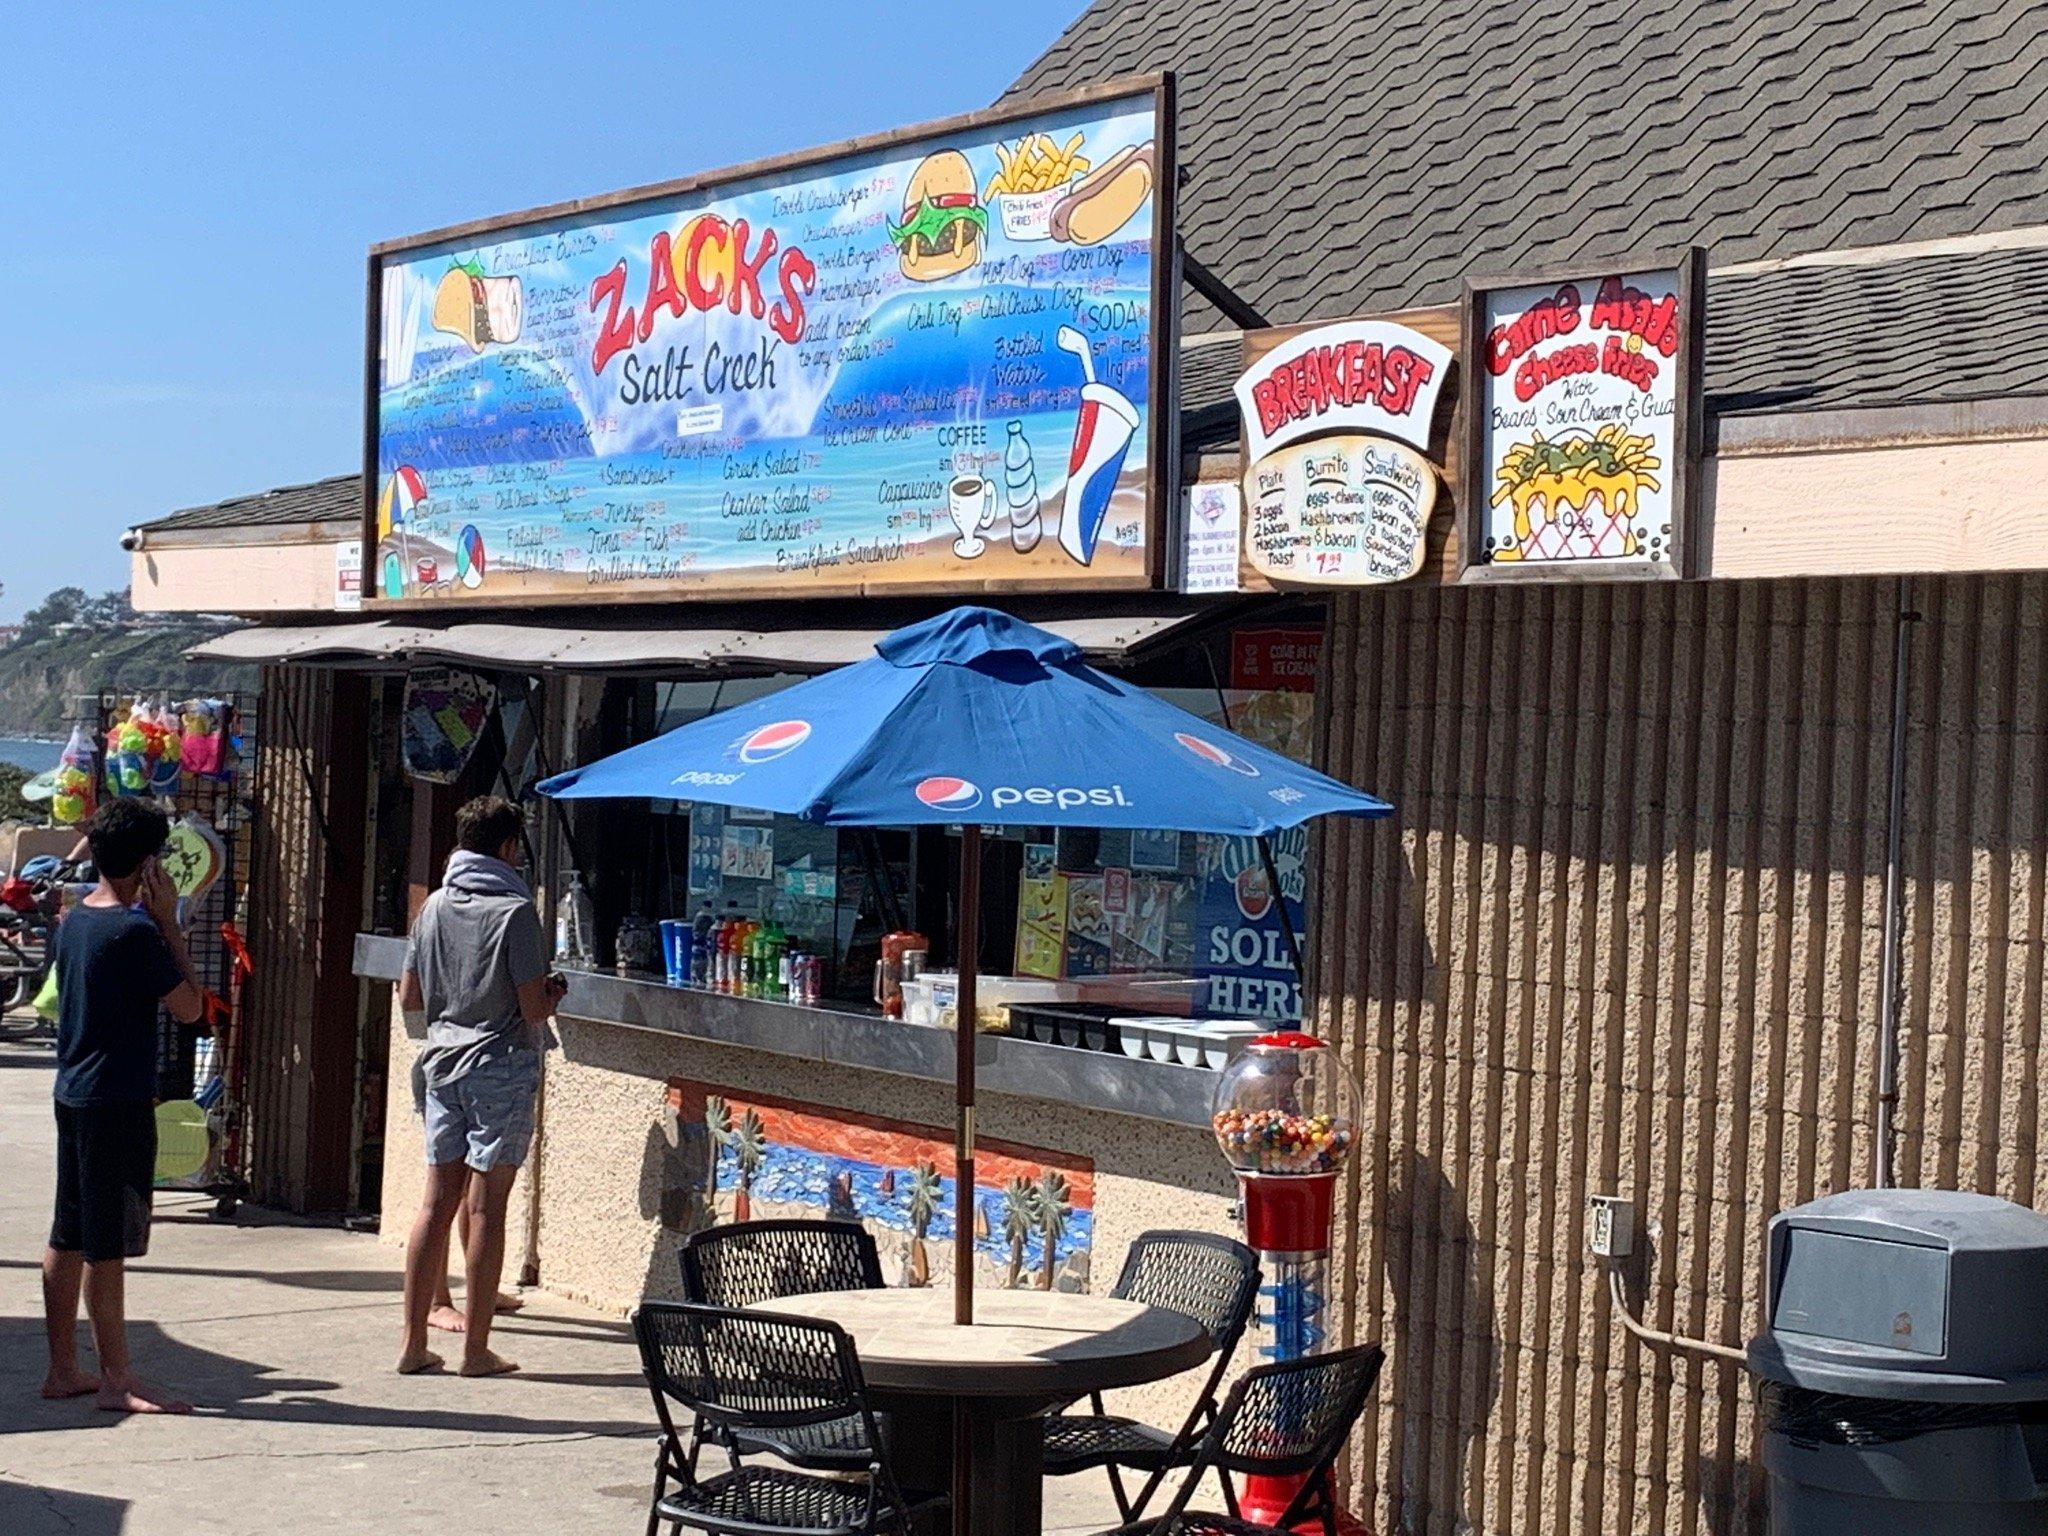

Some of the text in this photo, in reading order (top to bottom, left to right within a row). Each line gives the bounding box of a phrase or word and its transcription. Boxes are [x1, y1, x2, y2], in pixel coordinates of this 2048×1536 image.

[1062, 248, 1094, 273] Corn
[1051, 281, 1084, 323] Dog
[1088, 300, 1138, 333] SODA
[1485, 284, 1582, 376] Carne
[620, 345, 694, 404] Salt
[703, 336, 781, 395] Creek
[1514, 335, 1659, 403] Cheese Fries
[1253, 340, 1435, 439] BREAKFAST
[1491, 405, 1537, 430] Beans
[1546, 401, 1577, 426] Sour
[1579, 398, 1623, 423] Cream
[938, 426, 986, 447] COFFEE
[1306, 454, 1348, 479] Burrito
[1365, 449, 1421, 493] Sandwich
[1258, 472, 1284, 490] Plate
[1254, 503, 1283, 521] 3 eggs
[1372, 507, 1399, 529] bacon
[1253, 523, 1262, 538] 2
[1263, 522, 1290, 536] bacon
[1324, 528, 1356, 548] bacon
[1268, 551, 1295, 565] Toast
[991, 784, 1123, 810] pepsi
